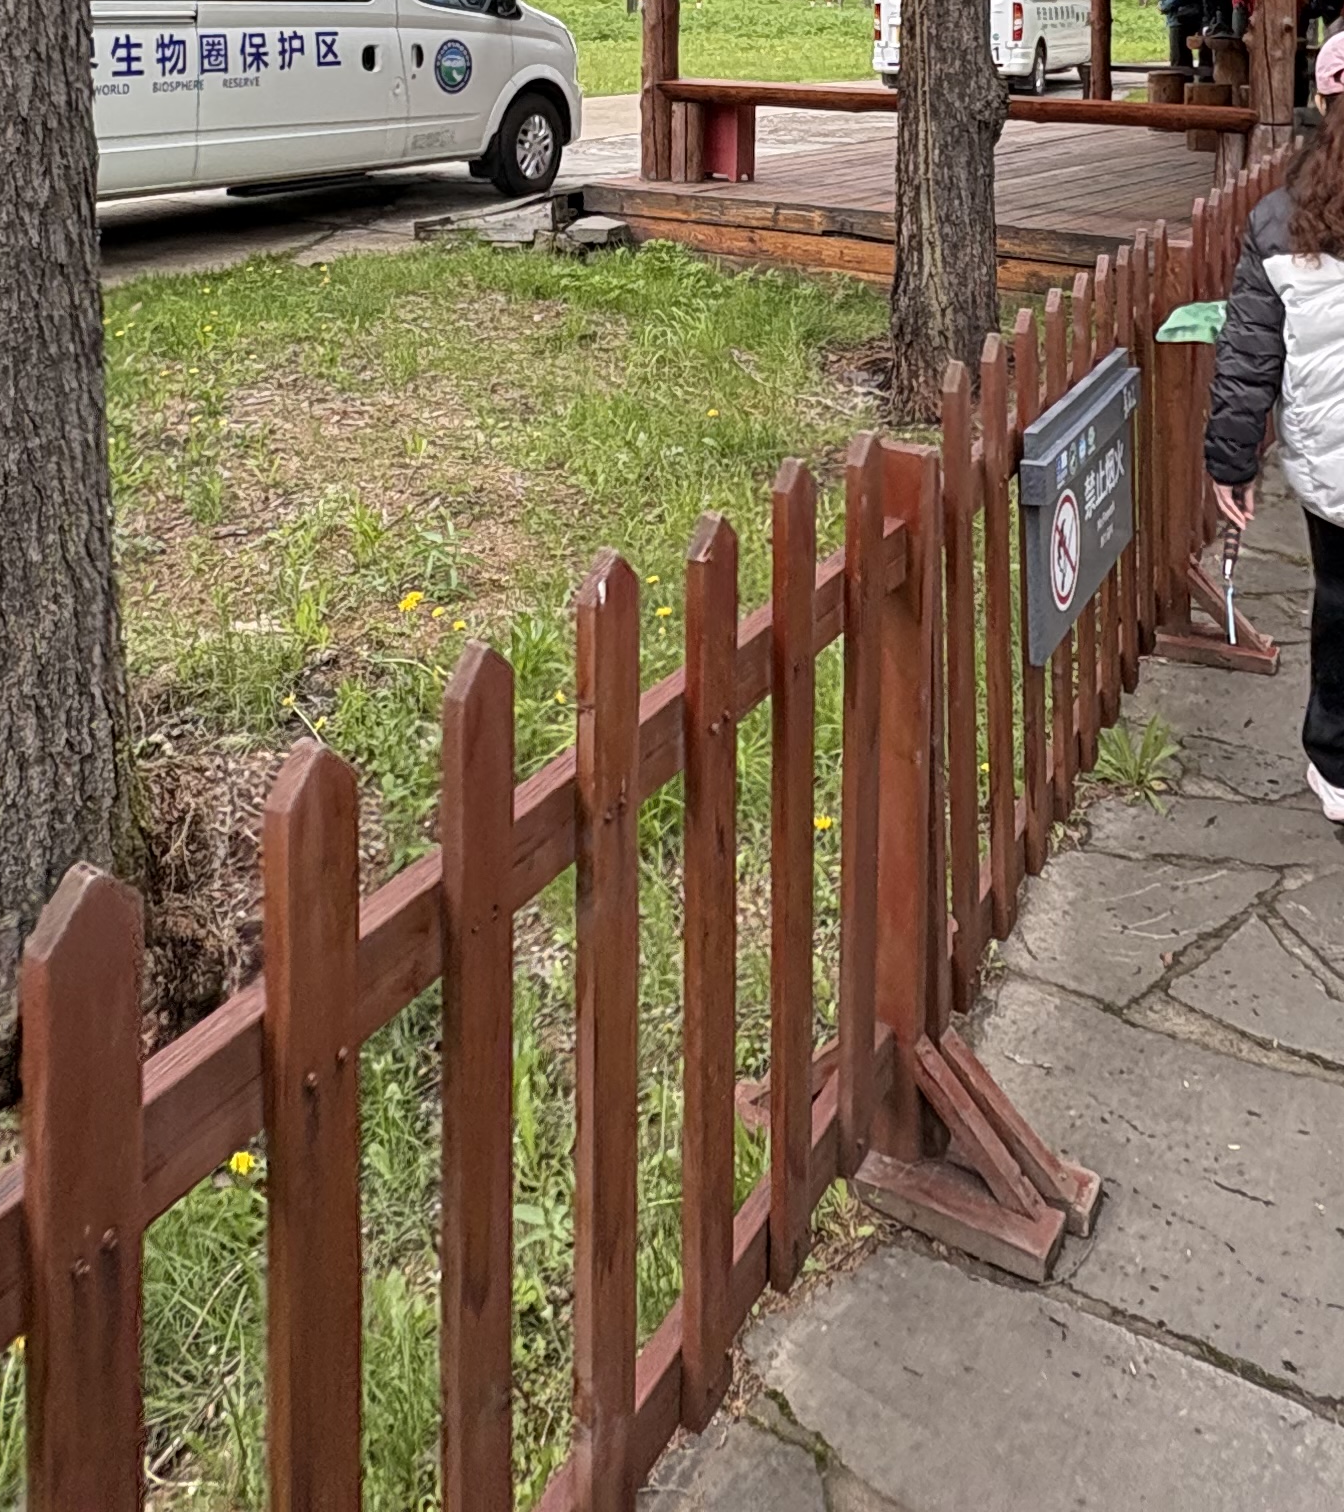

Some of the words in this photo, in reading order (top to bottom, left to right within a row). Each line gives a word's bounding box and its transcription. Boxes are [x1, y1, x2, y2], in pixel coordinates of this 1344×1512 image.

[90, 31, 342, 77] 生物圈保护区
[152, 79, 205, 94] BIOSPHERE
[222, 76, 261, 89] RESERVE
[1084, 439, 1125, 523] 禁止烟火
